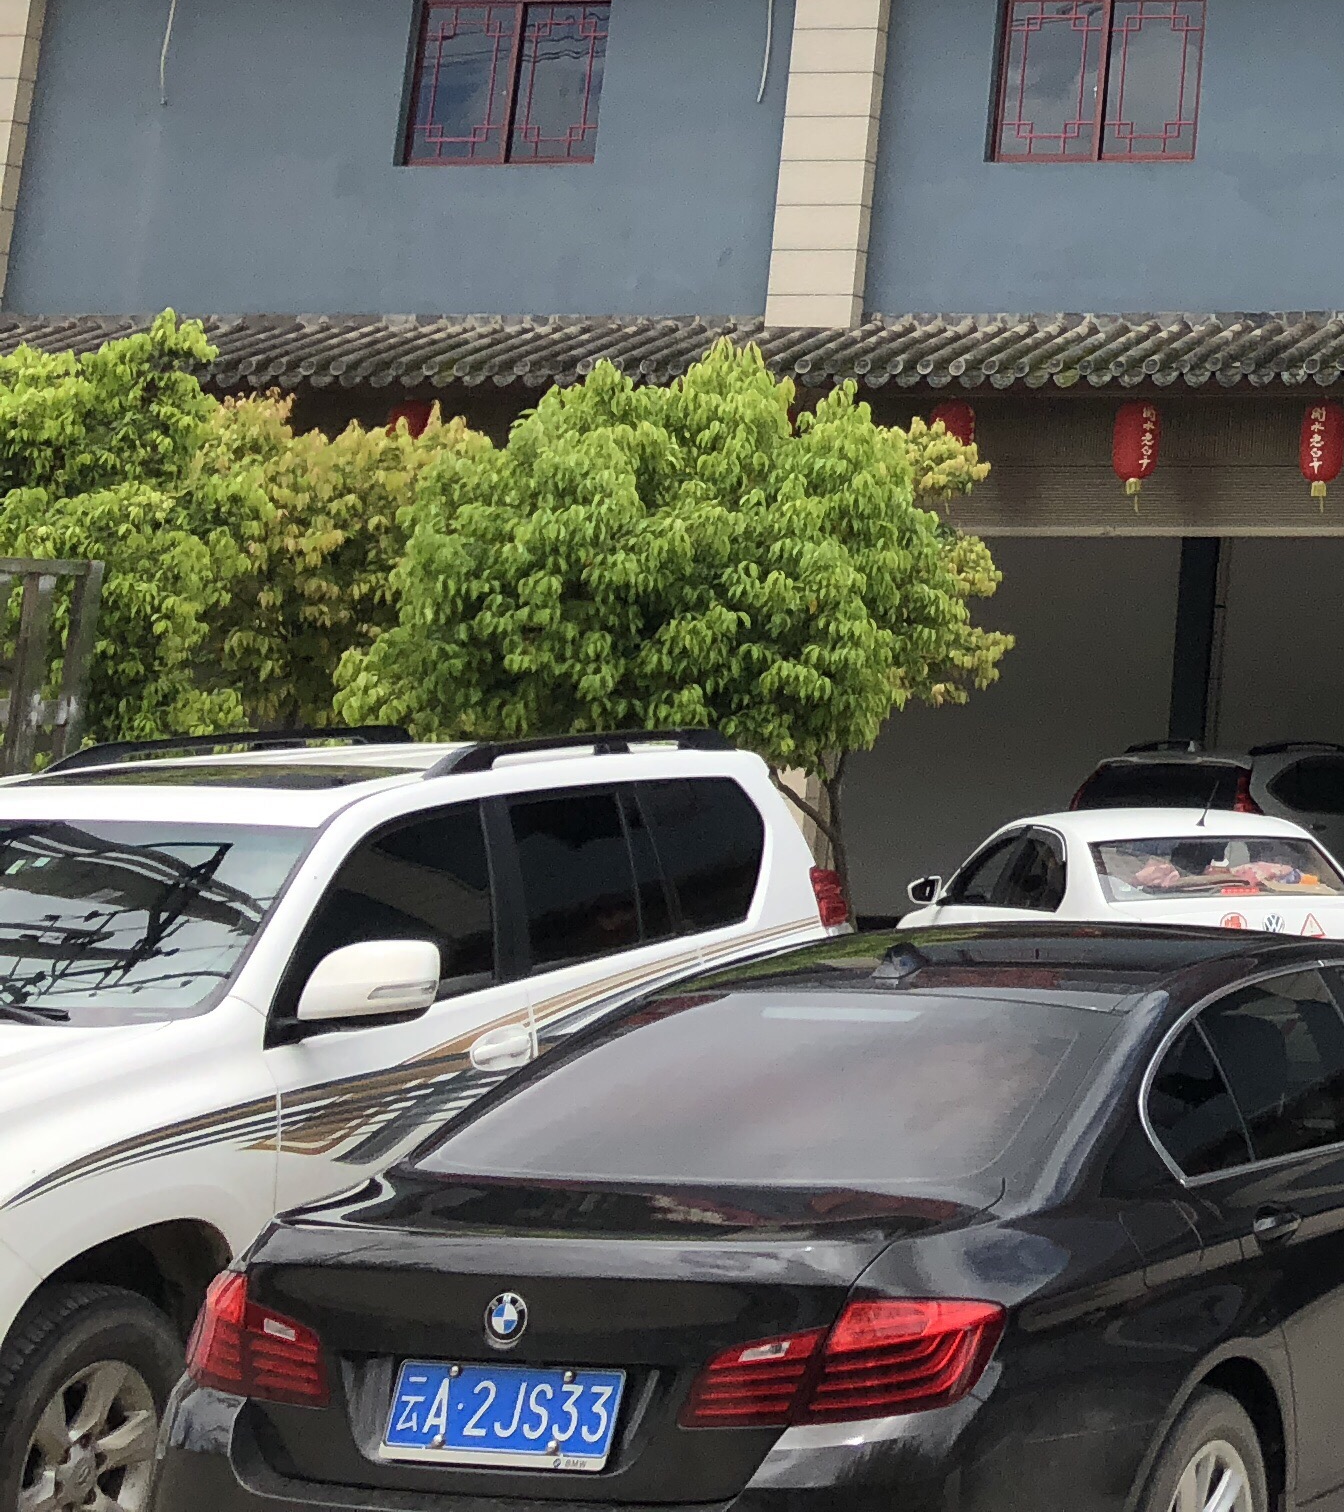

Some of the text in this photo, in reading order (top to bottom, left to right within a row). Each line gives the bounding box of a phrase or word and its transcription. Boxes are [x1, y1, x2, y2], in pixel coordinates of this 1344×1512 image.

[1308, 406, 1326, 474] 衡水老白干
[396, 1376, 613, 1442] 云A·2JS33
[564, 1459, 587, 1468] BMW
